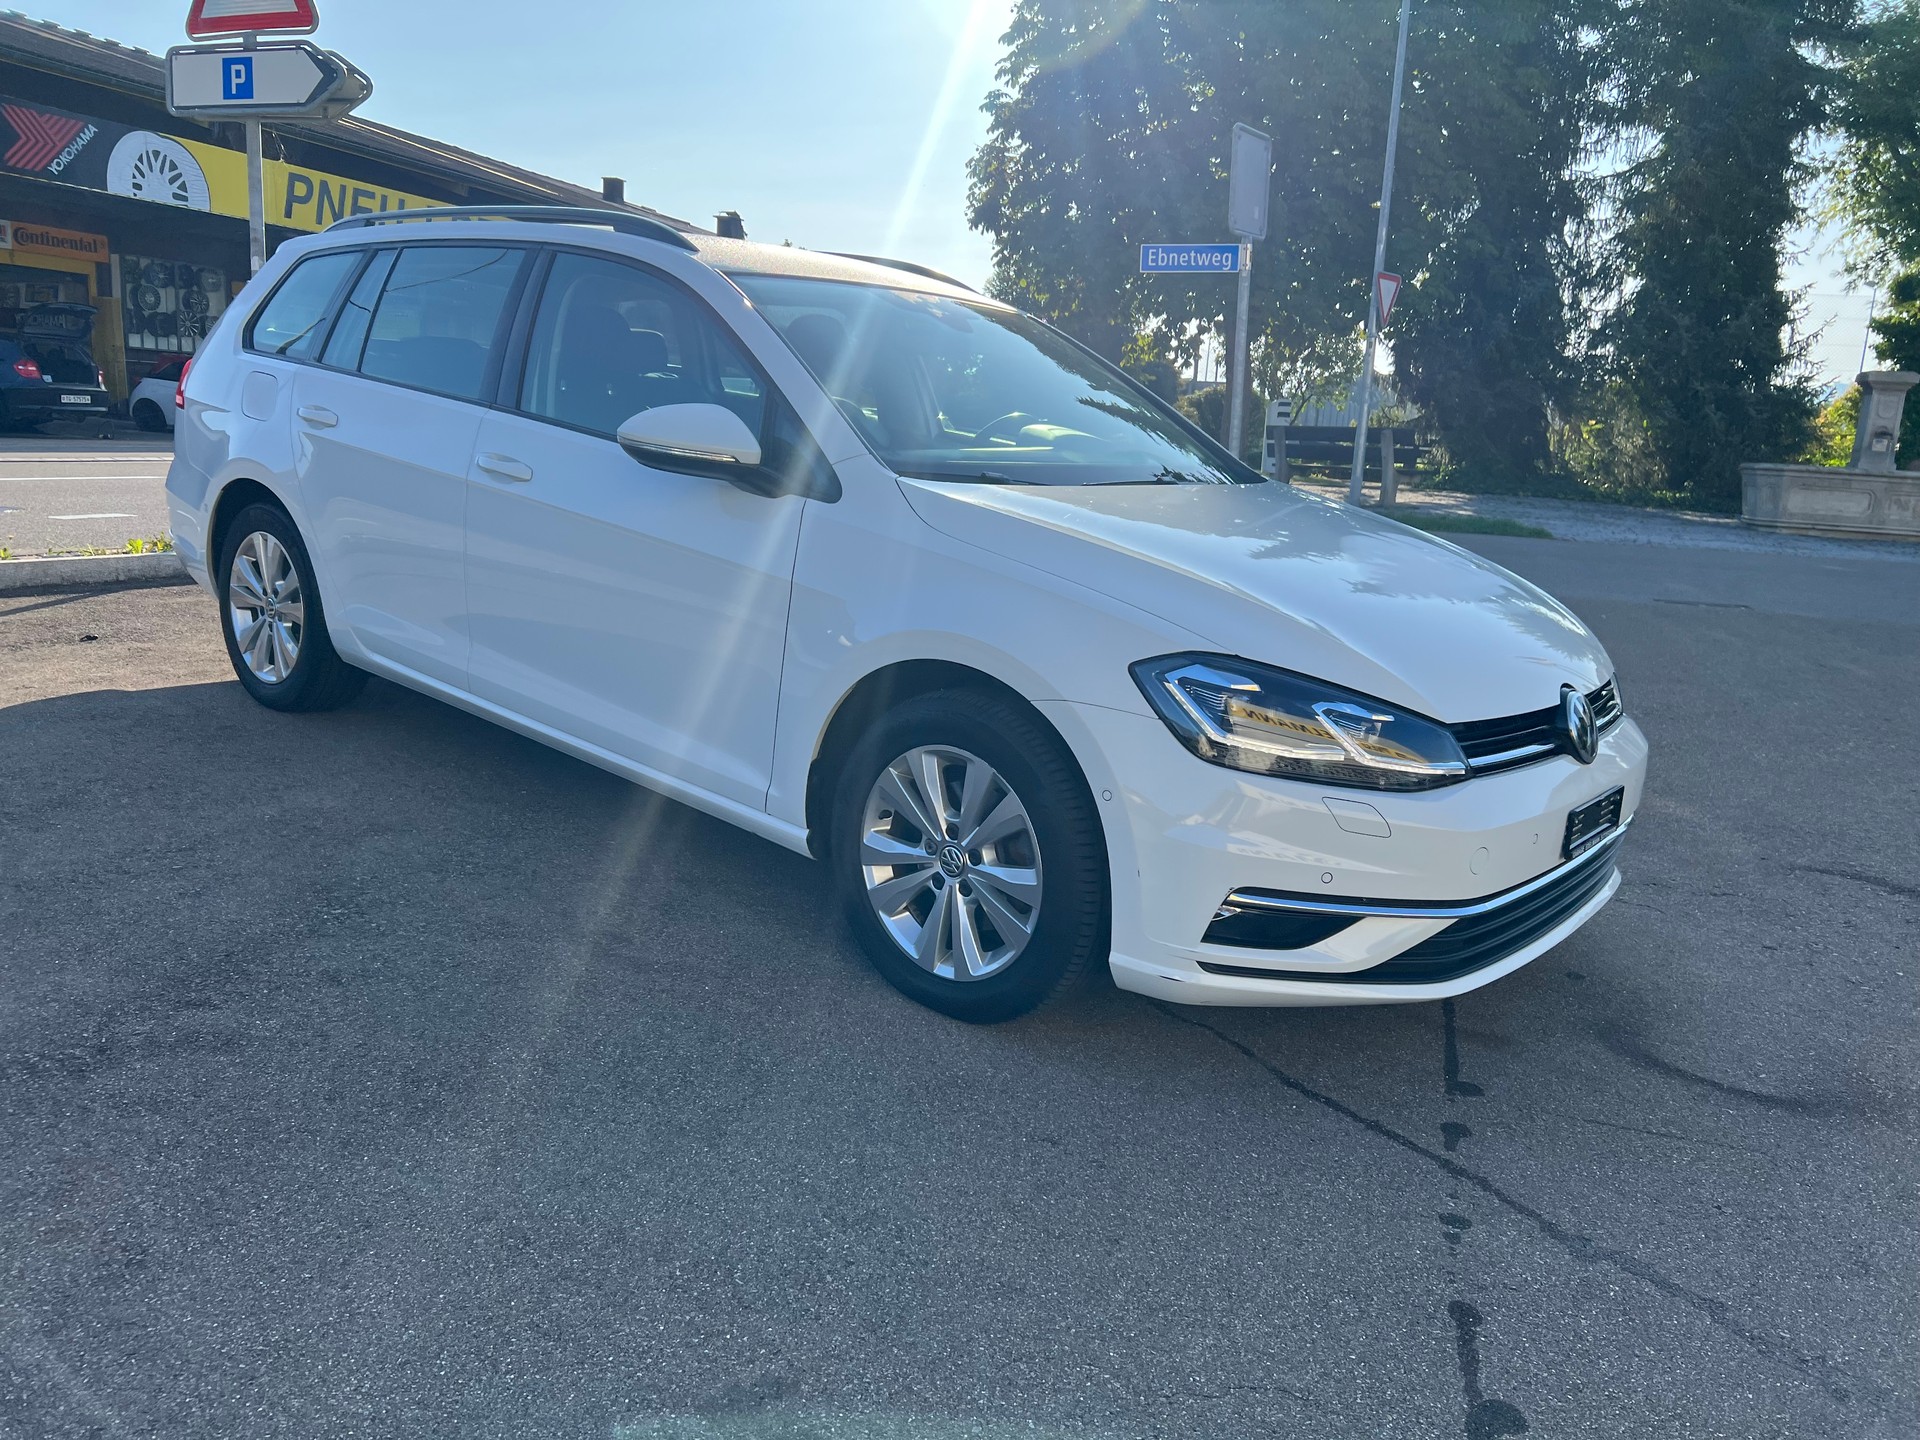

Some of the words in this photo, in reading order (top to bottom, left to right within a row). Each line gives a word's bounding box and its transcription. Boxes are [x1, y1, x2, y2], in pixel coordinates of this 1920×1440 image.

[231, 64, 246, 95] P
[47, 123, 99, 176] YOKOHAMA
[13, 227, 97, 253] Continental
[1148, 248, 1232, 271] Ebnetweg
